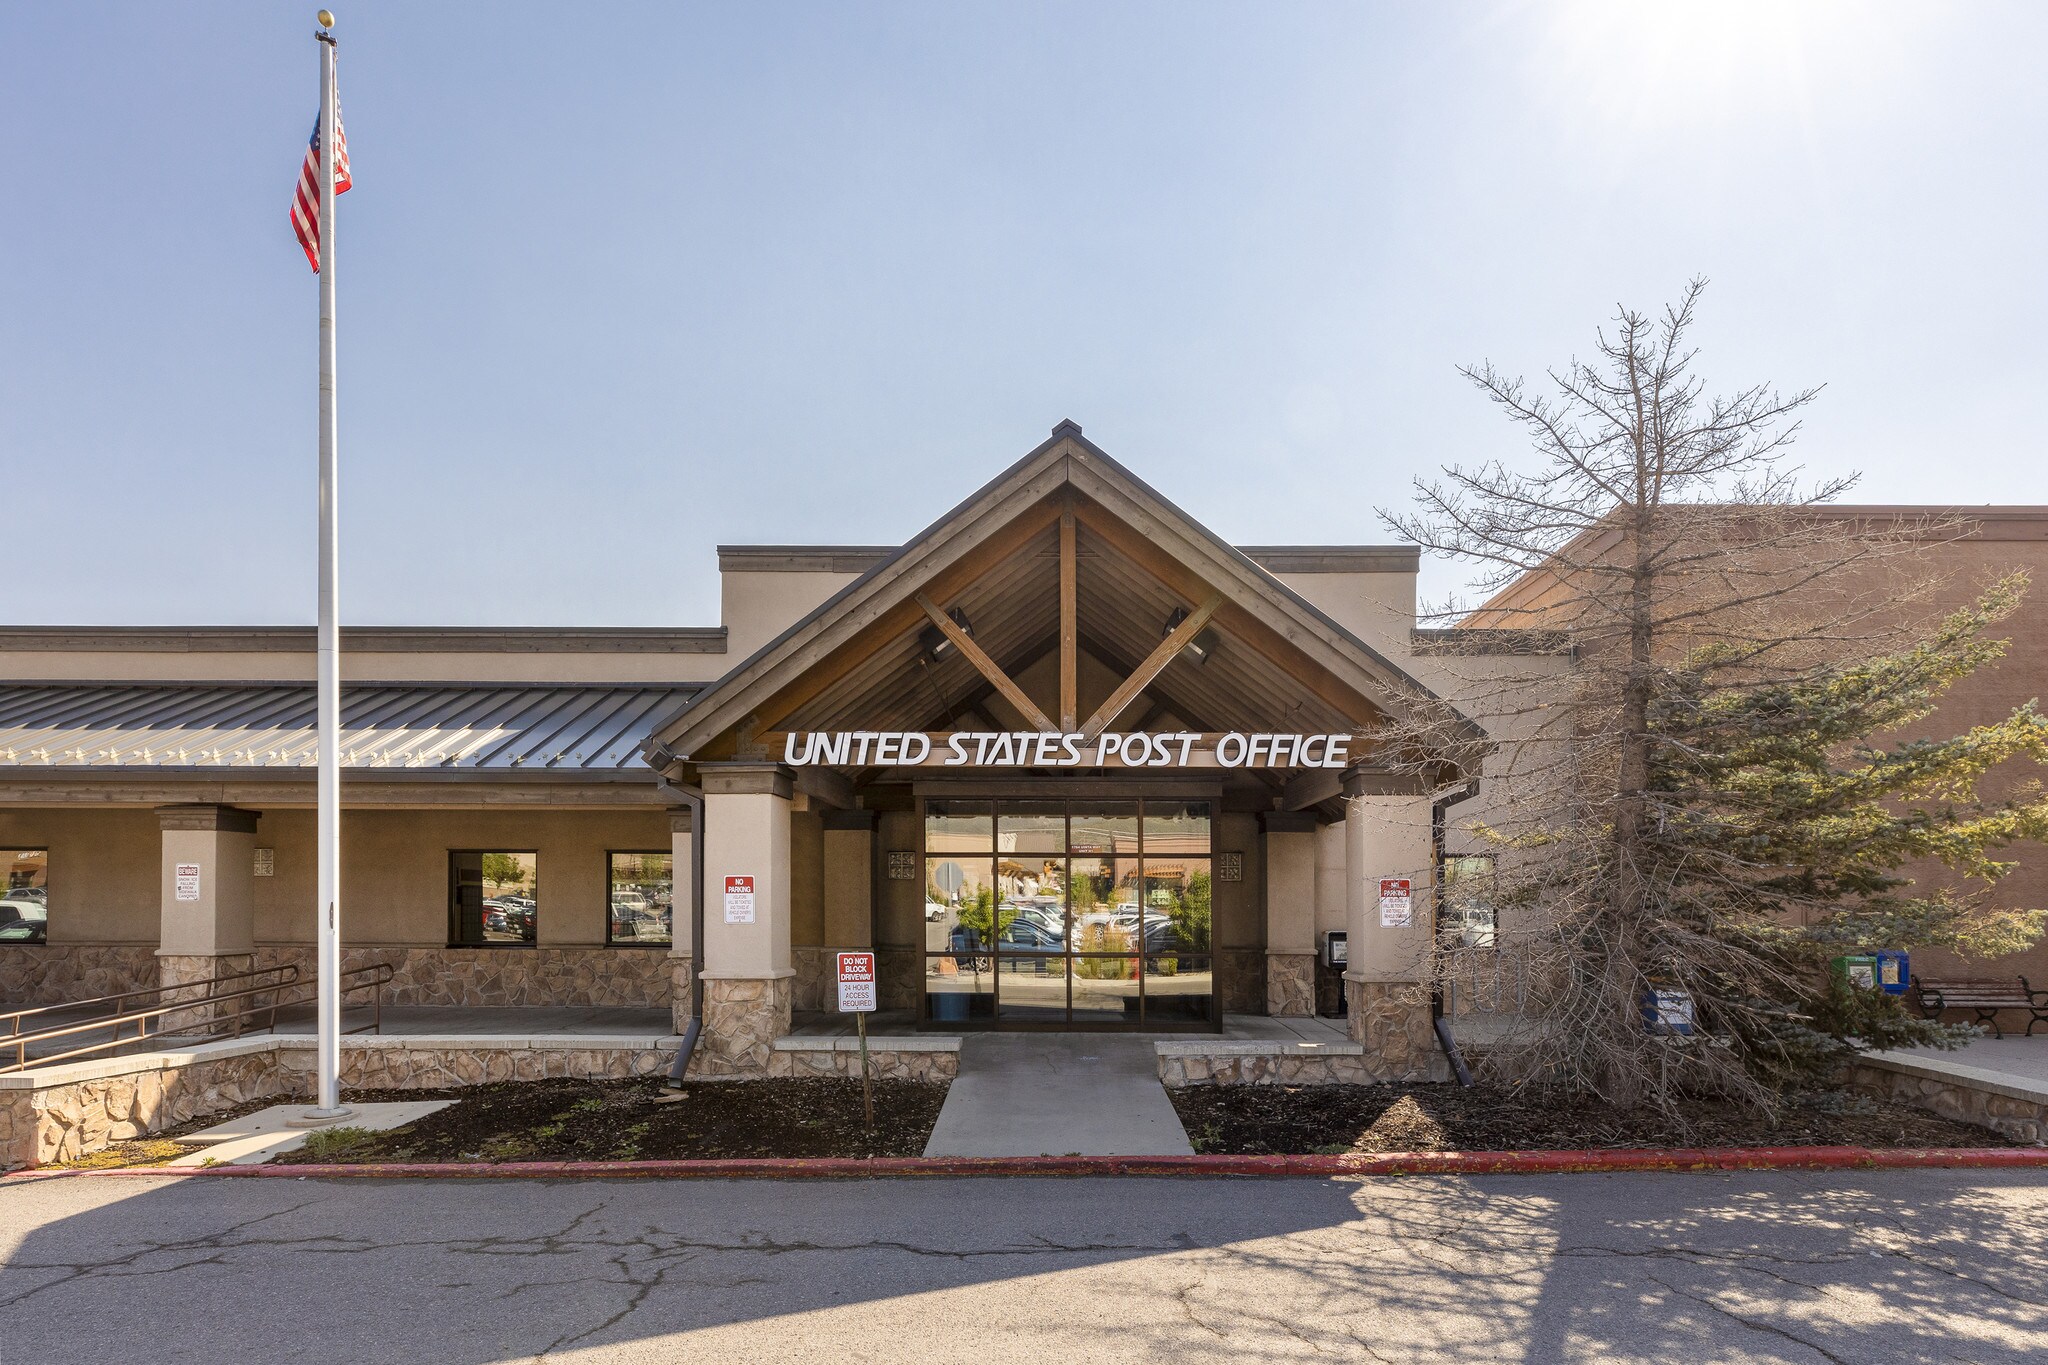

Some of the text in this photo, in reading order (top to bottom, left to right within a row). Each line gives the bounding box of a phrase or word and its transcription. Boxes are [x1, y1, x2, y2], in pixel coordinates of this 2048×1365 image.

[784, 732, 1352, 768] UNITED STATES POST OFFICE
[178, 867, 198, 875] BEWARE
[735, 878, 744, 886] NO
[1390, 881, 1400, 889] NO
[728, 885, 751, 893] PARKING
[1383, 889, 1407, 897] PARKING
[843, 957, 868, 965] DO NOT
[845, 965, 867, 973] BLOCK
[840, 973, 872, 981] DRIVEWAY
